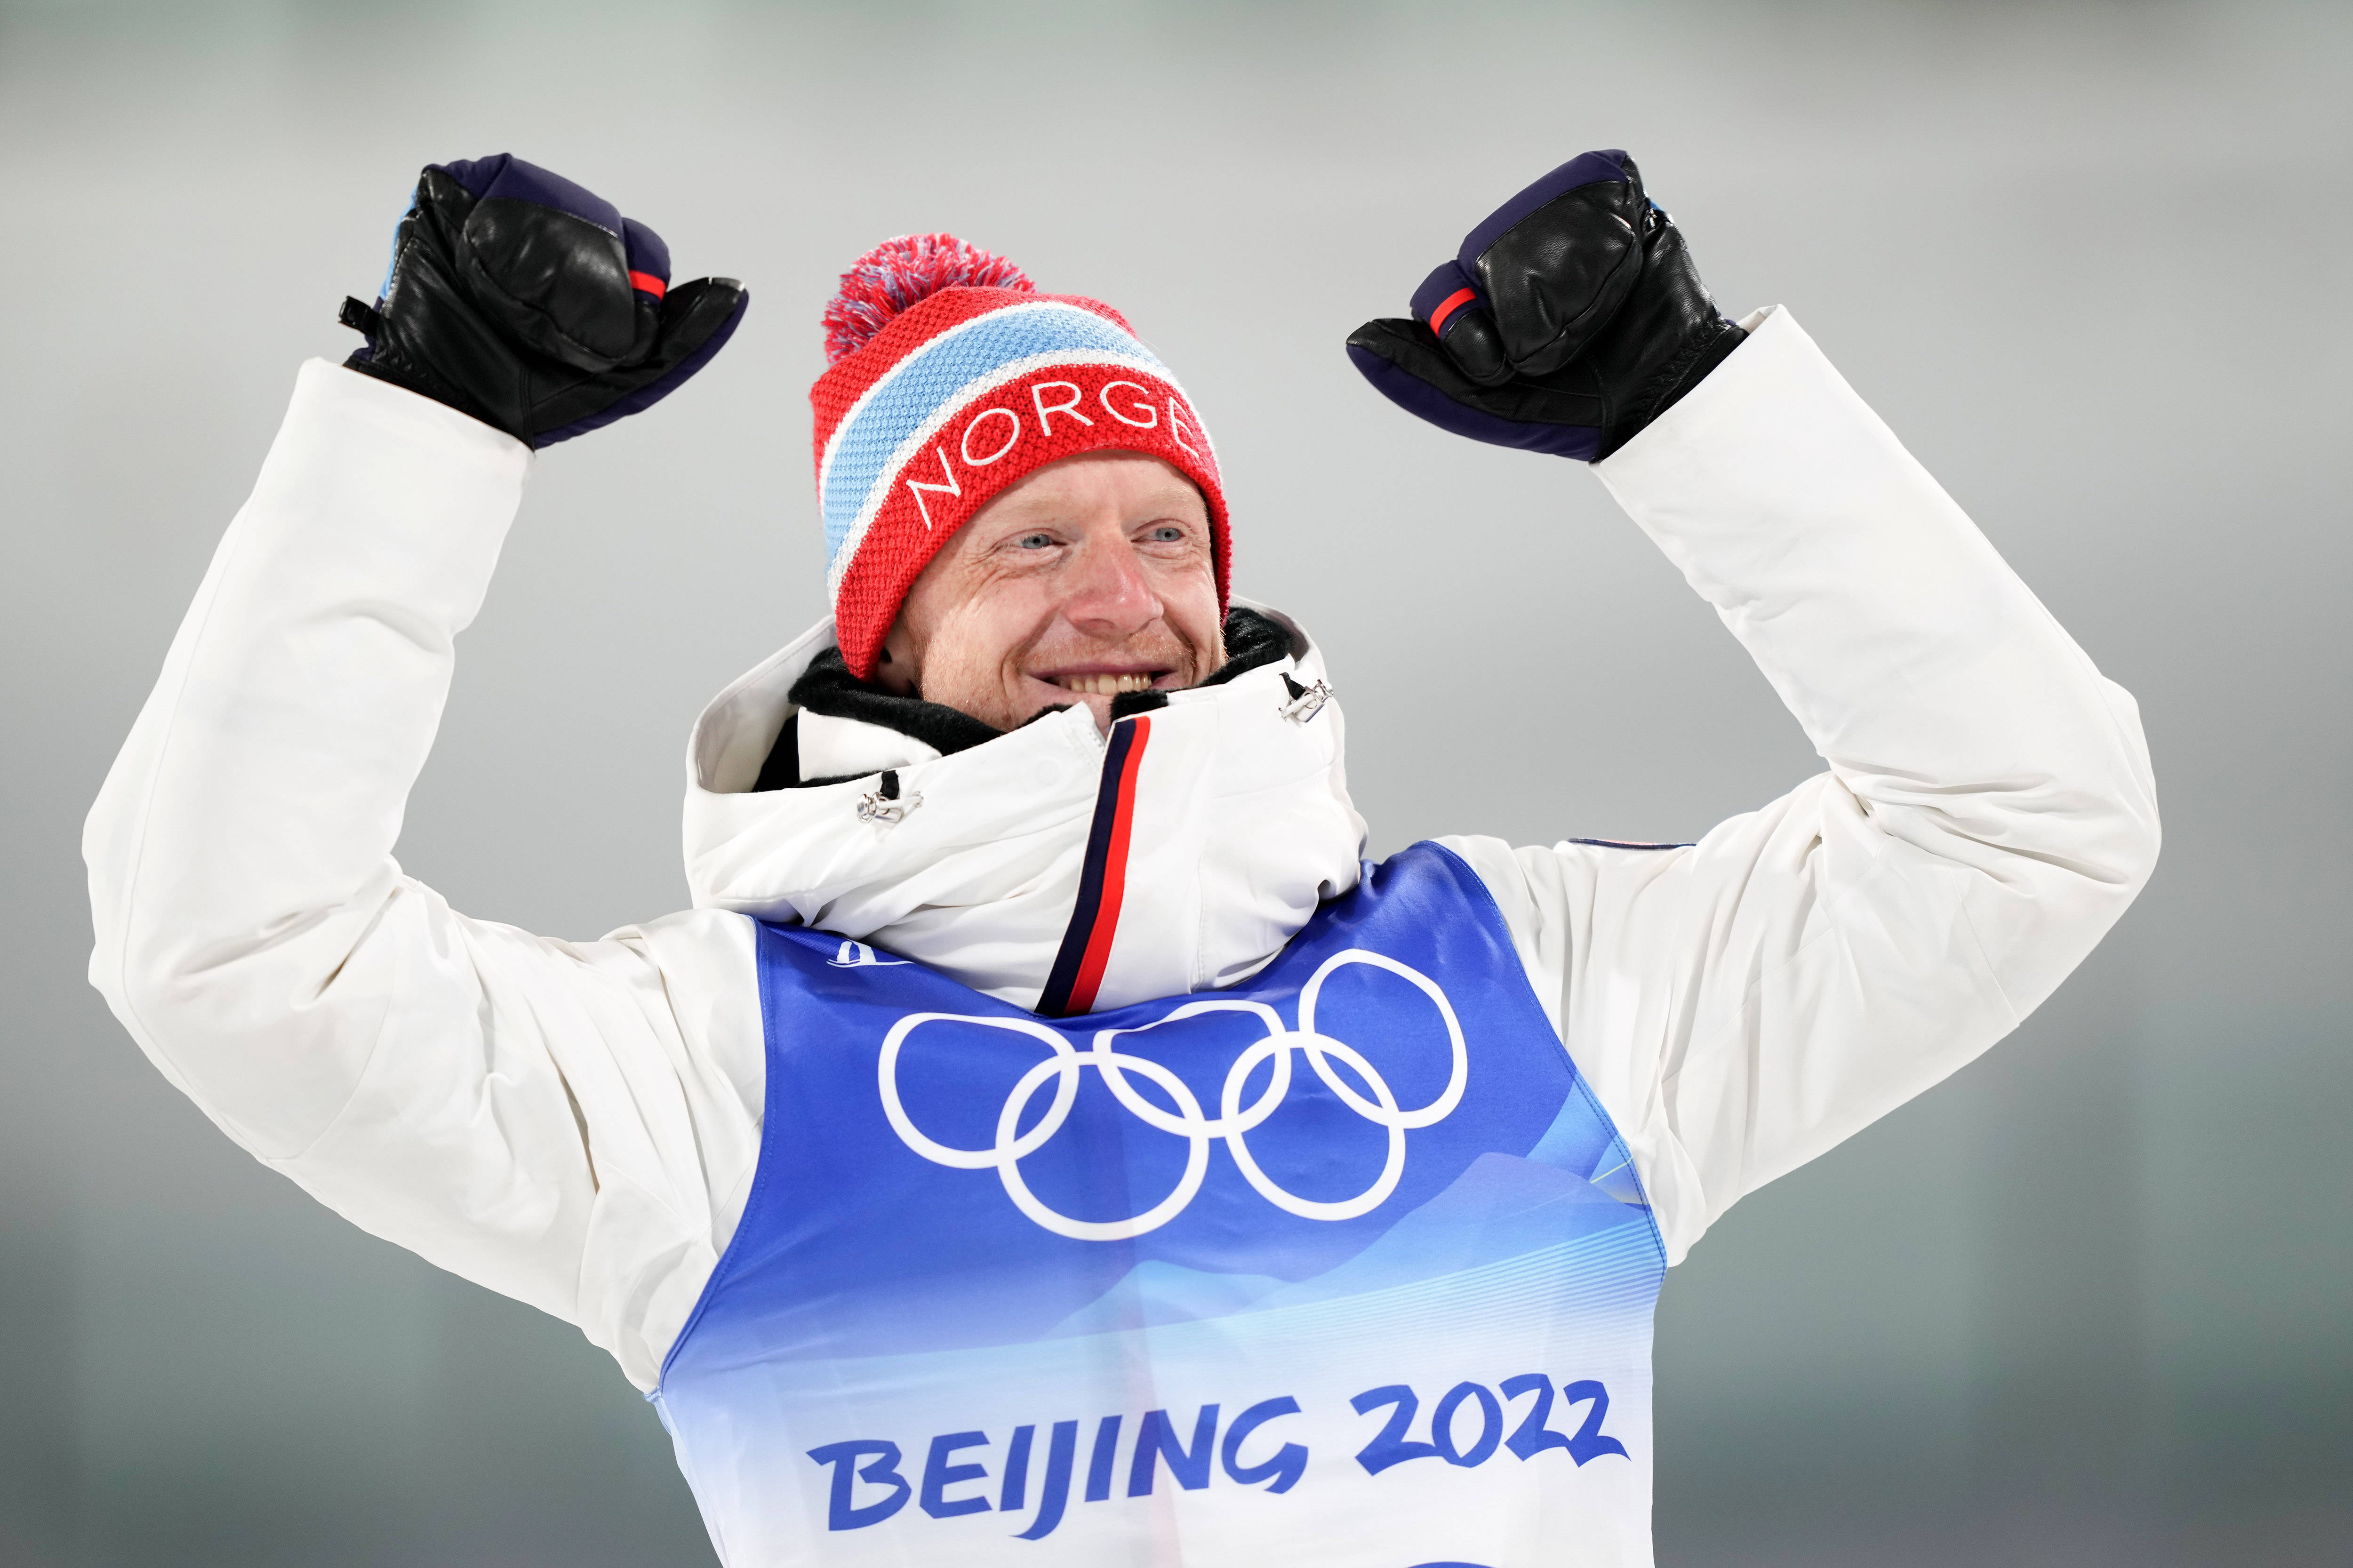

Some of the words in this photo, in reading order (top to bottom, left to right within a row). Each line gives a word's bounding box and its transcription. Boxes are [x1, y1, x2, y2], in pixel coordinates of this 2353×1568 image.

[906, 381, 1199, 530] NORGE
[806, 1395, 1308, 1541] BEIJING
[1349, 1373, 1631, 1476] 2022
